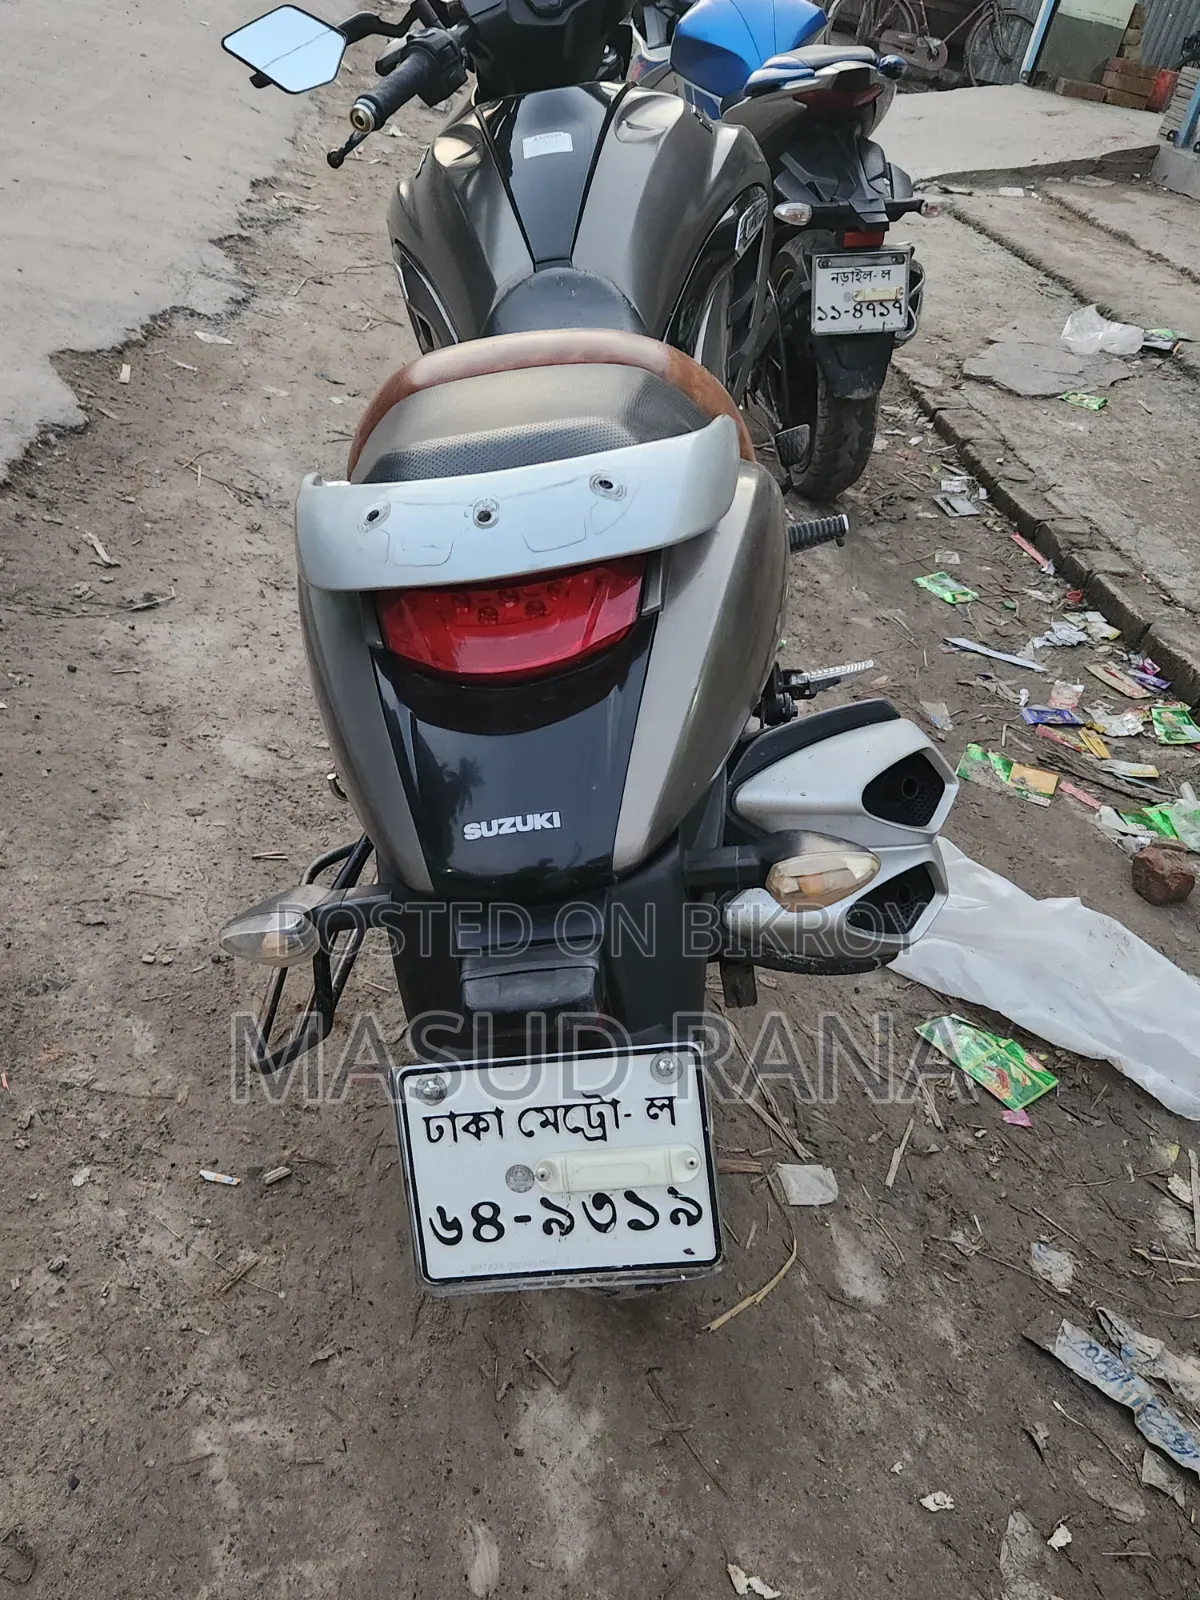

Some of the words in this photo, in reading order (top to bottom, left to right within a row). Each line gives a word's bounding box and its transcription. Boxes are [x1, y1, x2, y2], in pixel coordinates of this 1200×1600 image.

[816, 300, 903, 322] ১১-৪৭১৭
[463, 811, 561, 840] SUZUKI
[421, 1106, 505, 1144] ঢাকা
[428, 1186, 703, 1246] ৬৪-৯৩১৯
